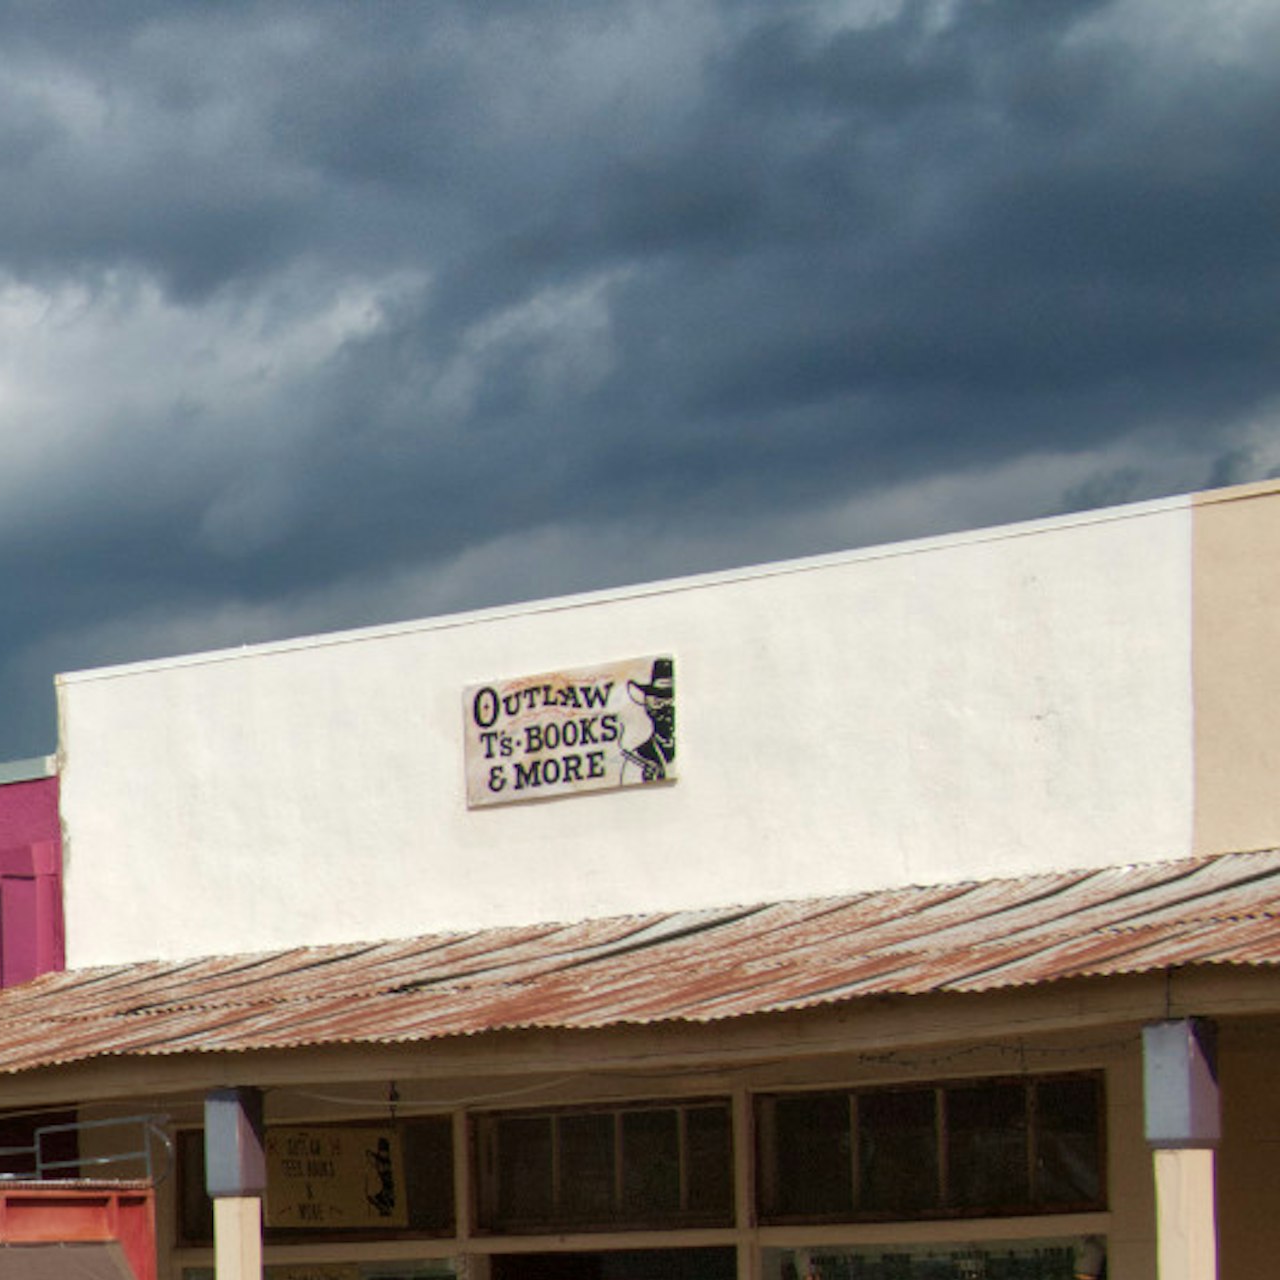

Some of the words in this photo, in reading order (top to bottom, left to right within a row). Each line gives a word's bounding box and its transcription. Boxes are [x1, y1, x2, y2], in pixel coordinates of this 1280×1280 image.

[473, 681, 615, 728] OUTLAW
[488, 765, 507, 793] &
[514, 752, 605, 791] MORE
